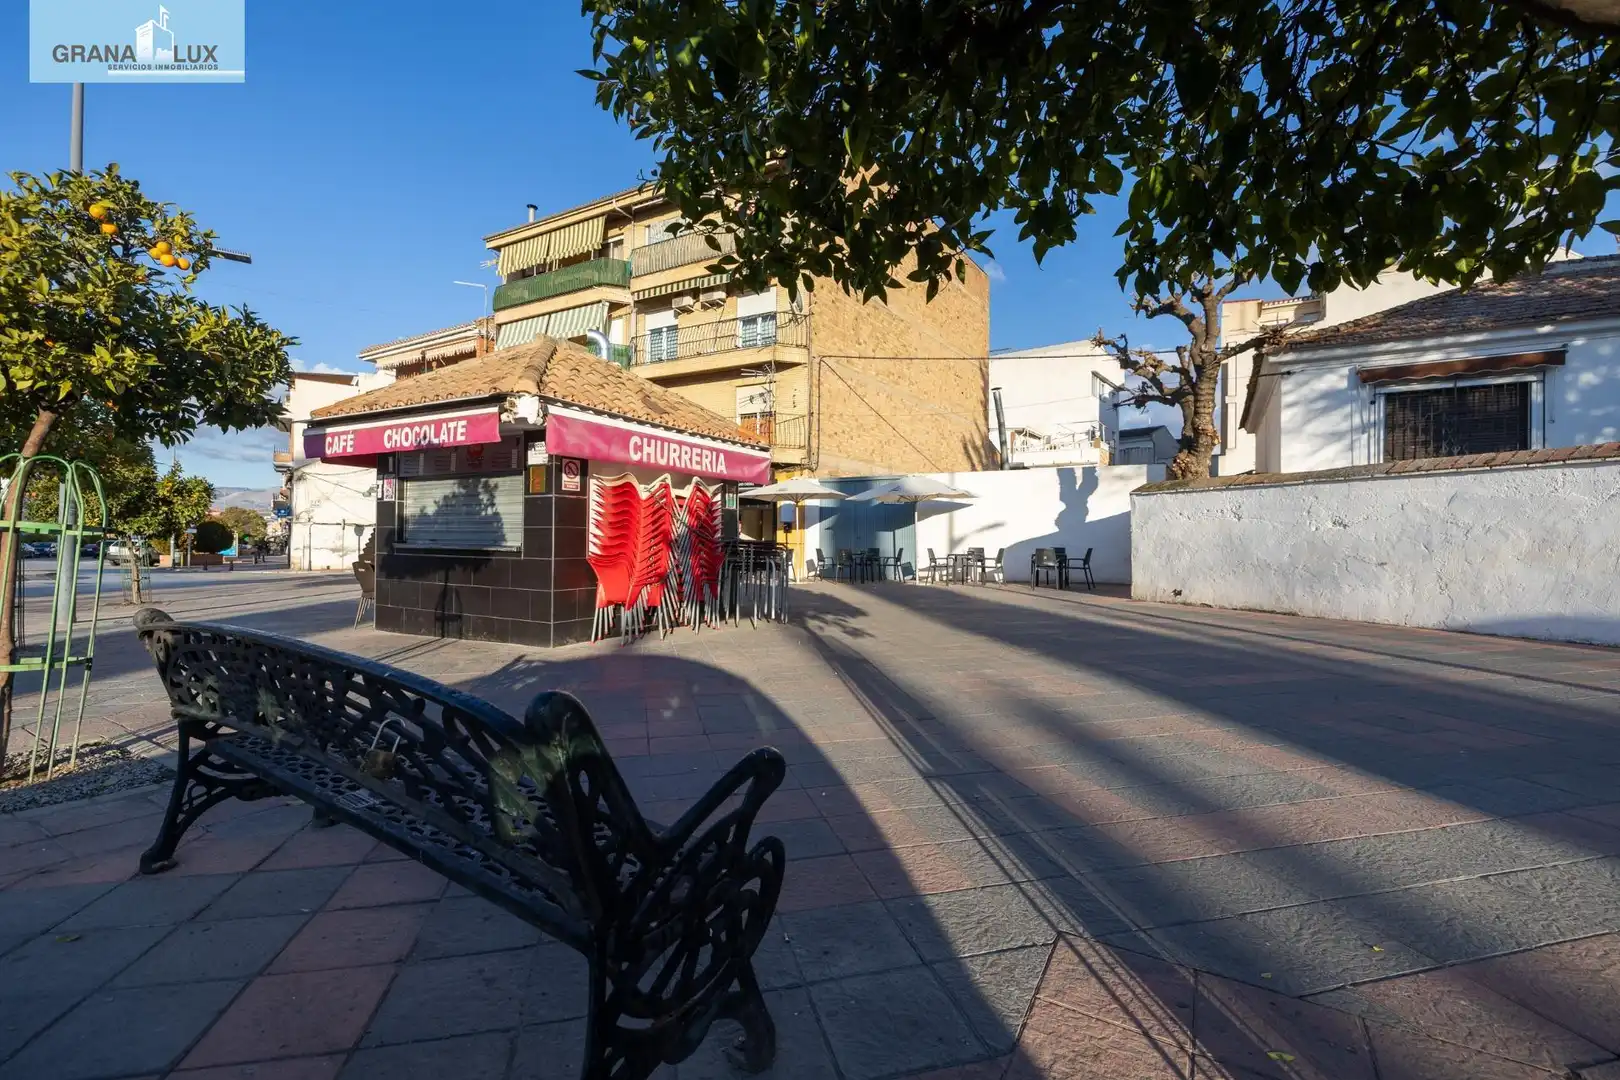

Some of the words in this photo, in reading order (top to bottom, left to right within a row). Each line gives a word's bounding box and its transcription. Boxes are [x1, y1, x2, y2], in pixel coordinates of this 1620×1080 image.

[325, 431, 354, 455] CAFÉ
[383, 420, 468, 448] CHOCOLATE
[629, 435, 727, 475] CHURRERIA
